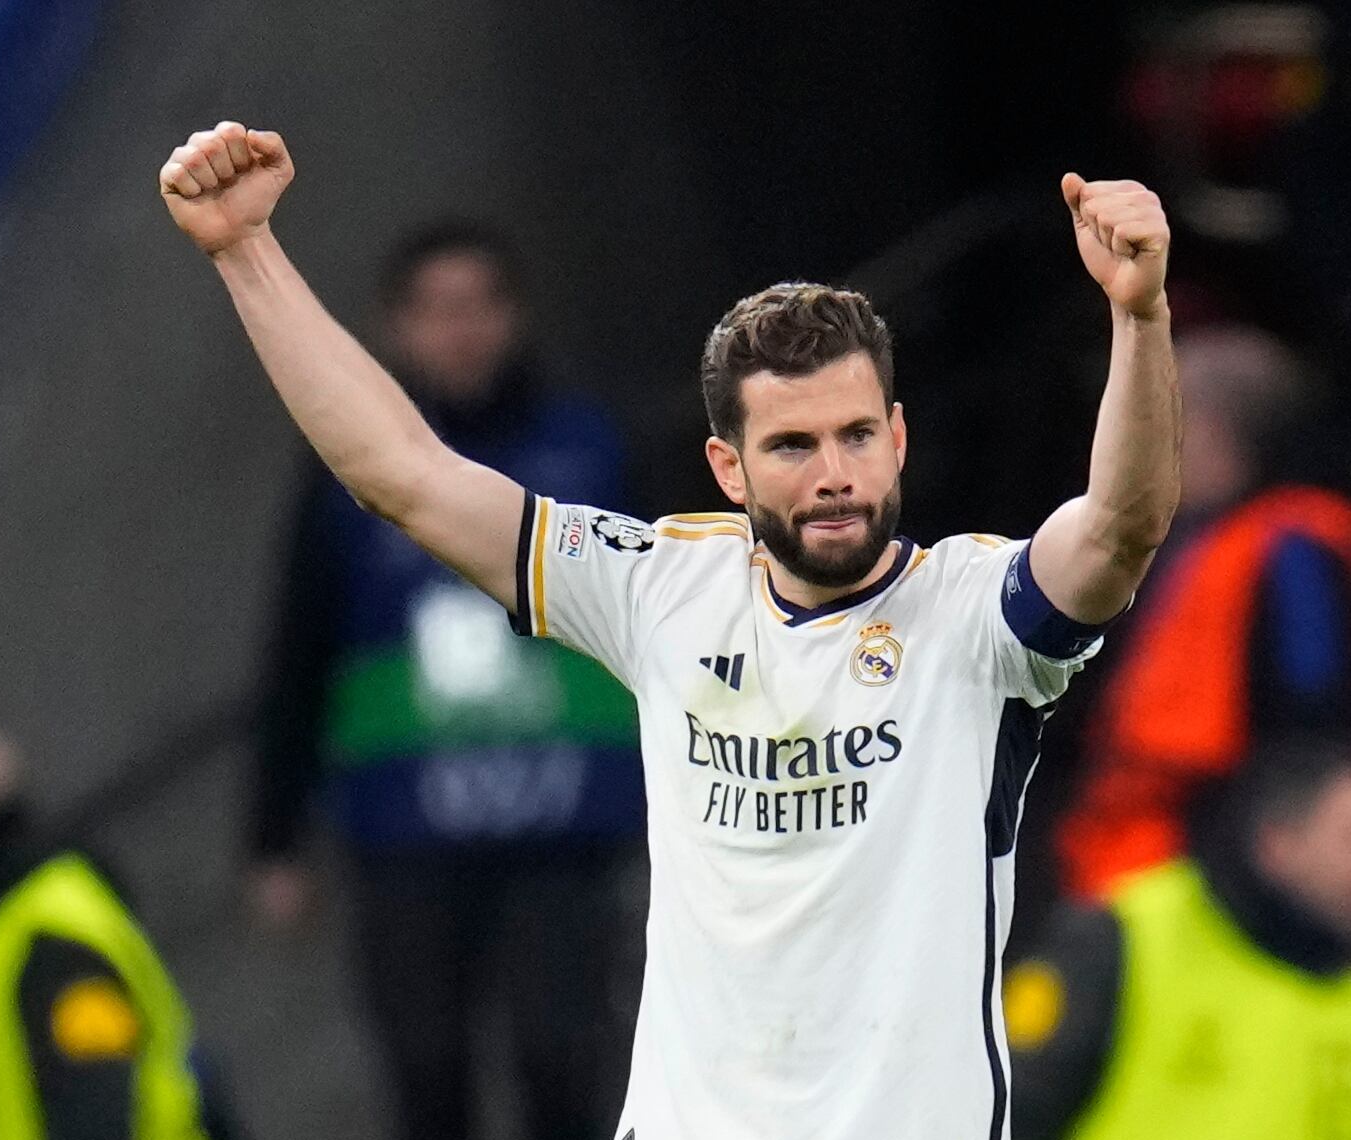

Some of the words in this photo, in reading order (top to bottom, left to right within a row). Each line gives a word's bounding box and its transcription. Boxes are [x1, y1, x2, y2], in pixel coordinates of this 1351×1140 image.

[684, 710, 903, 781] Emirates
[703, 781, 746, 828] FLY
[756, 780, 868, 833] BETTER
